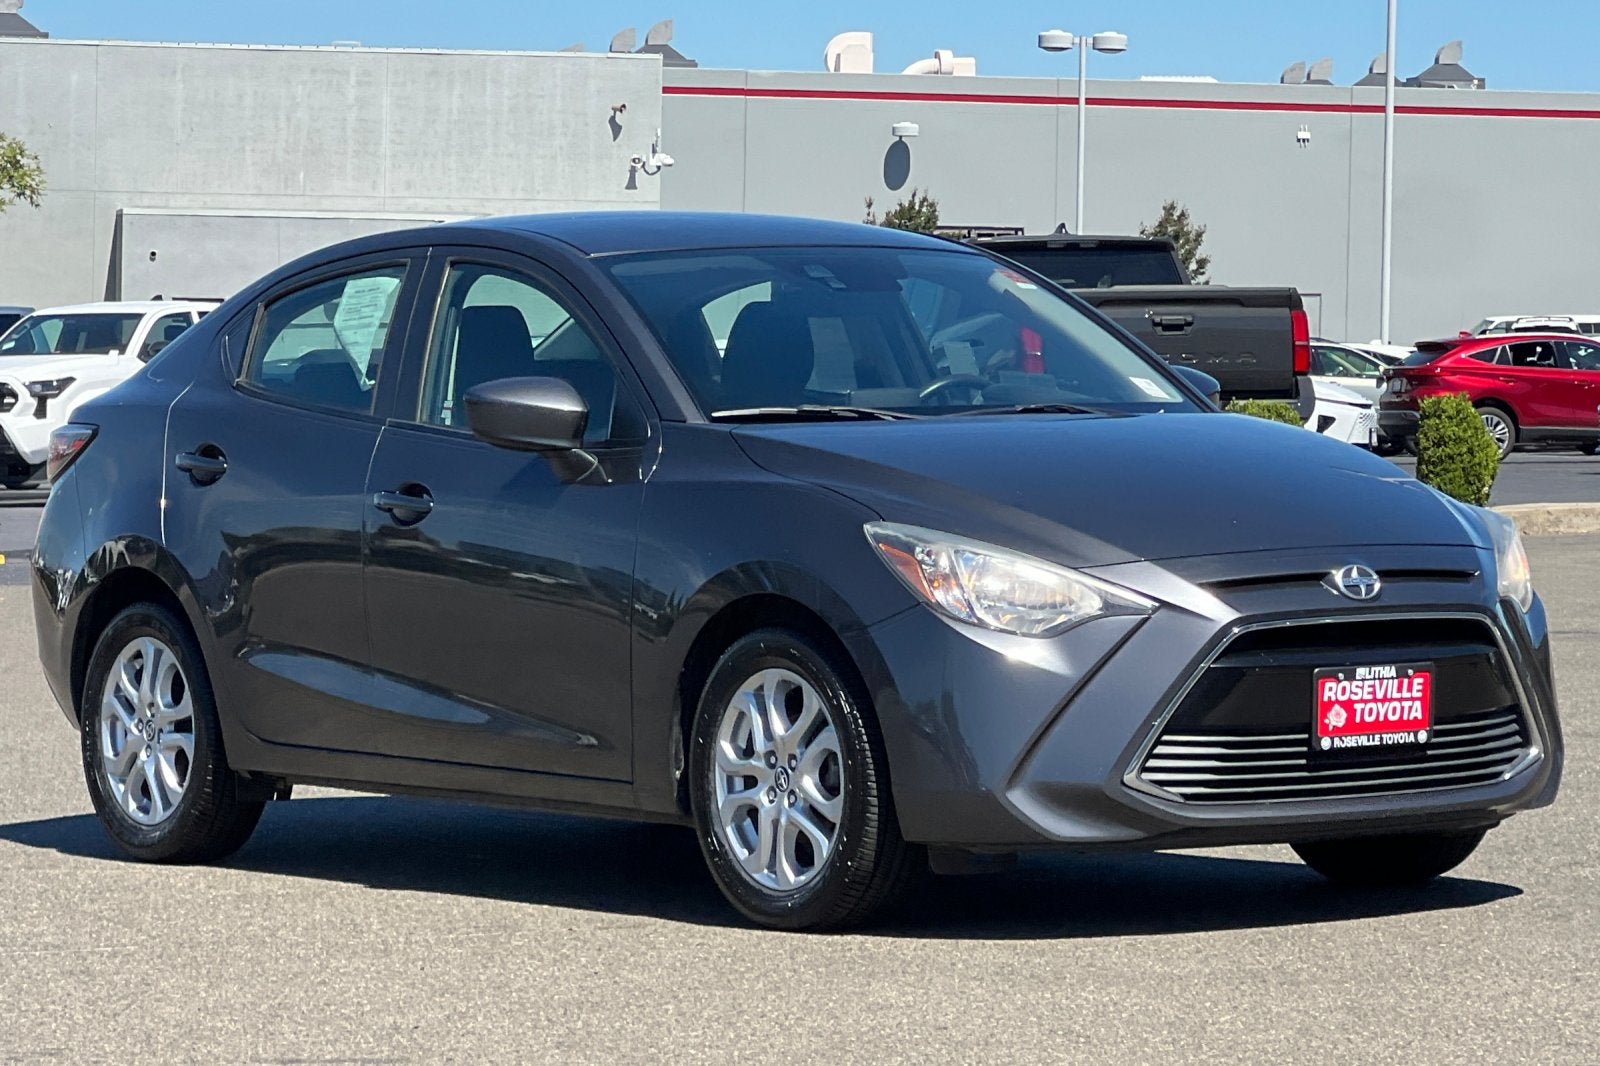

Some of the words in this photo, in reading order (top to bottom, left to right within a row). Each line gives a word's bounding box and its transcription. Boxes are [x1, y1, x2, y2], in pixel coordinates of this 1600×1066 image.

[1366, 666, 1397, 679] LITHIA
[1323, 678, 1424, 702] ROSEVILLE
[1353, 700, 1423, 723] TOYOTA
[1333, 734, 1381, 748] ROSEVILLE
[1381, 732, 1415, 745] TOYOTA
